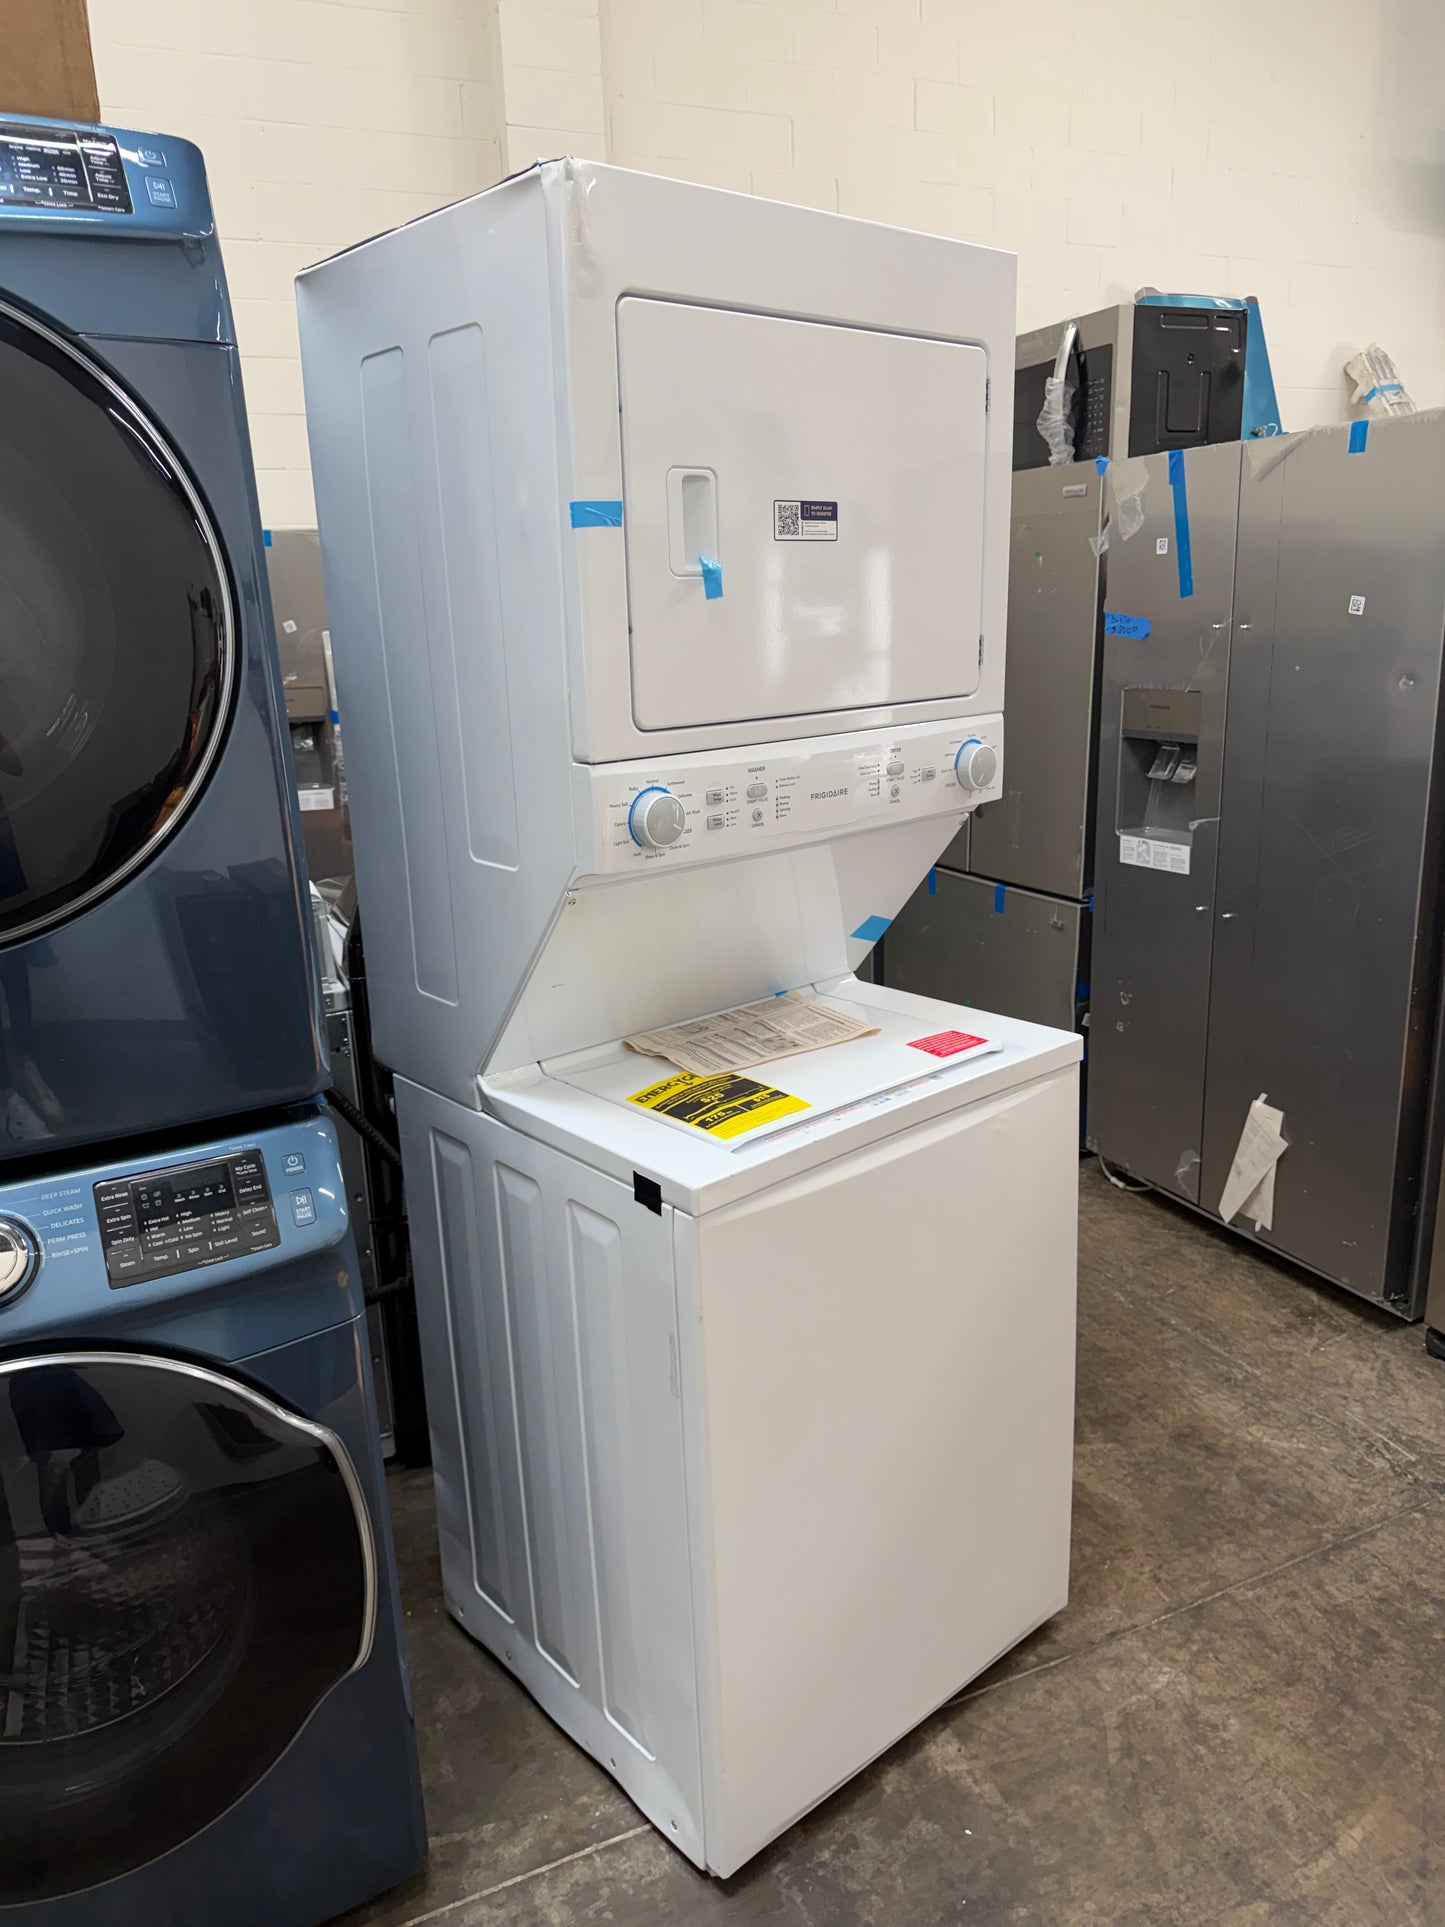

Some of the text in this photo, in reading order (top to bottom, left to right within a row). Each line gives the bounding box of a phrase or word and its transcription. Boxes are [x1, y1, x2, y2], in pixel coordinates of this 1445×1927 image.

[810, 788, 848, 800] FRIGIDAIRE
[634, 1074, 700, 1104] ENERGYG
[286, 1164, 304, 1173] POWER
[42, 1188, 80, 1200] DEEP STEAM
[42, 1203, 82, 1216] QUICK WASH
[120, 1214, 132, 1222] Spin
[182, 1216, 200, 1224] Medium
[216, 1216, 233, 1224] Normal
[296, 1212, 312, 1220] PAUSE
[50, 1217, 84, 1229] DELICATES
[151, 1232, 166, 1240] Warm
[252, 1228, 266, 1237] Sound
[48, 1232, 86, 1244] PERM PRESS
[225, 1237, 238, 1245] Level
[188, 1246, 200, 1254] Spin
[153, 1254, 168, 1262] Temp.
[120, 1260, 136, 1268] Steam
